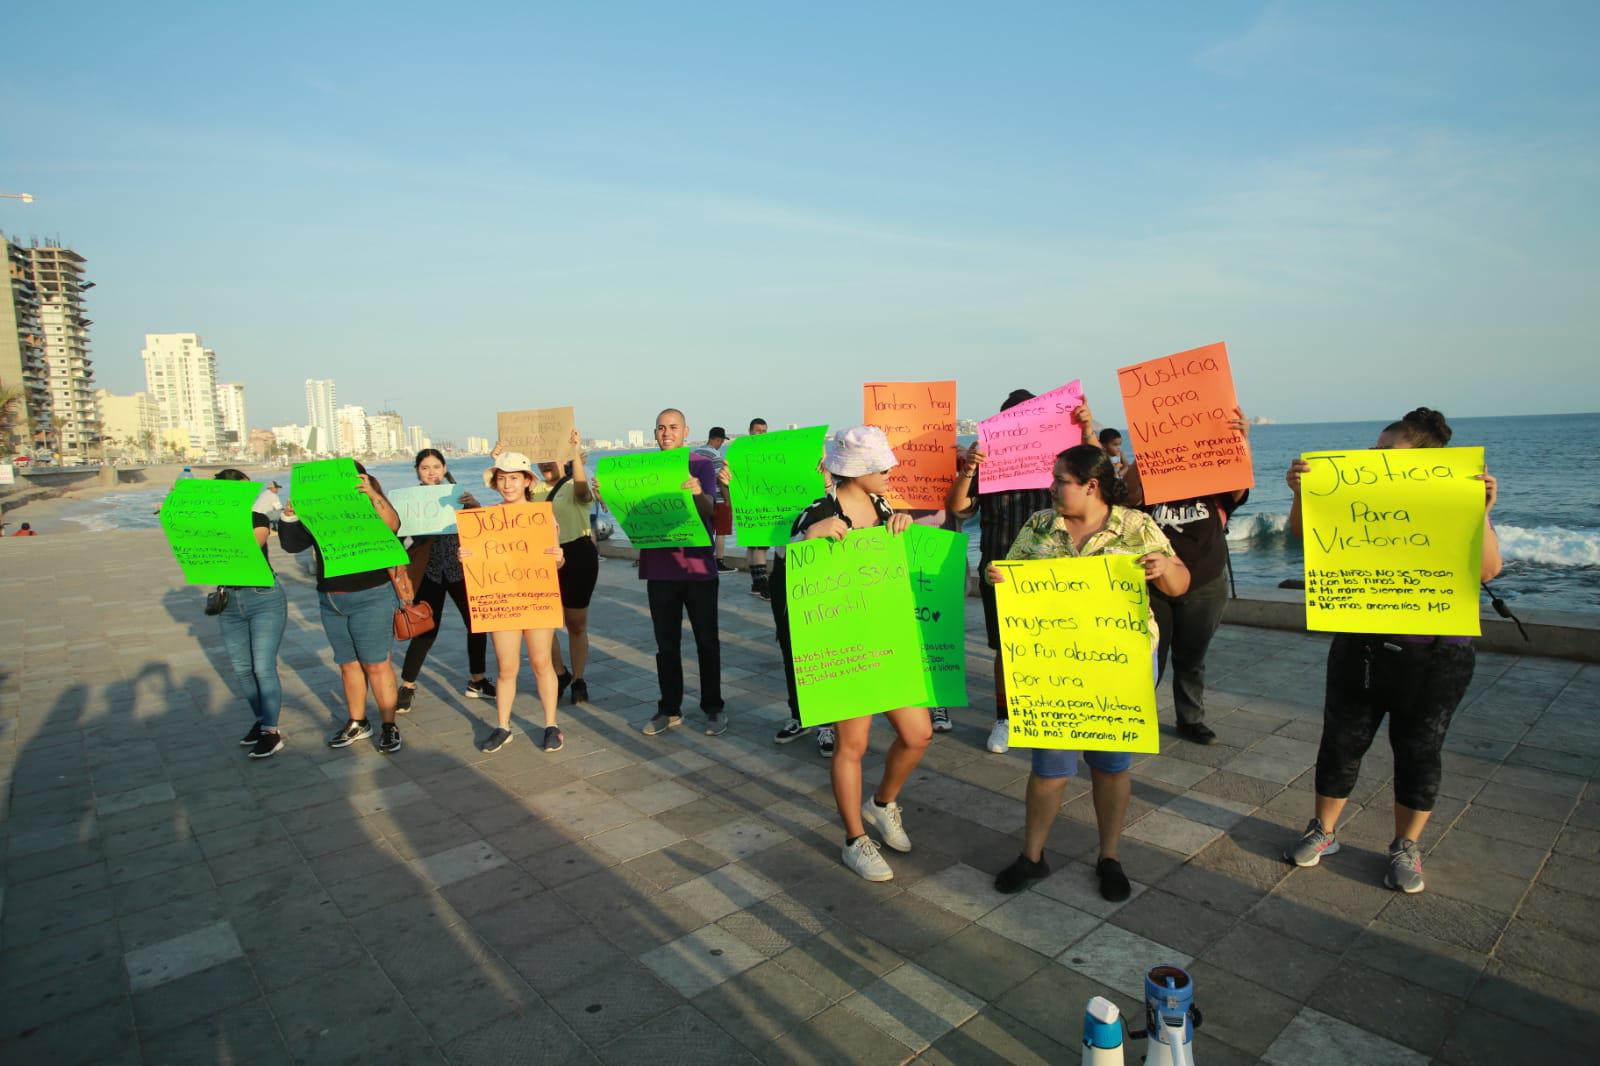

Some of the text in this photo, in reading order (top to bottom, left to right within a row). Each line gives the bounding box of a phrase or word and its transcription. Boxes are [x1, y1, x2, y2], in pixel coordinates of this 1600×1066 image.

[1119, 357, 1218, 398] Justicia
[928, 387, 950, 415] hay
[1152, 389, 1200, 414] para
[1133, 407, 1227, 444] Victoria
[1306, 452, 1454, 496] Justicia
[406, 500, 440, 518] NO
[457, 508, 548, 540] Justicia
[1313, 525, 1430, 553] Victoria
[466, 561, 550, 589] Victoria
[792, 572, 851, 600] abuso
[995, 558, 1143, 604] Tambien hay
[1004, 615, 1078, 636] mujeres
[1064, 642, 1128, 664] abusada
